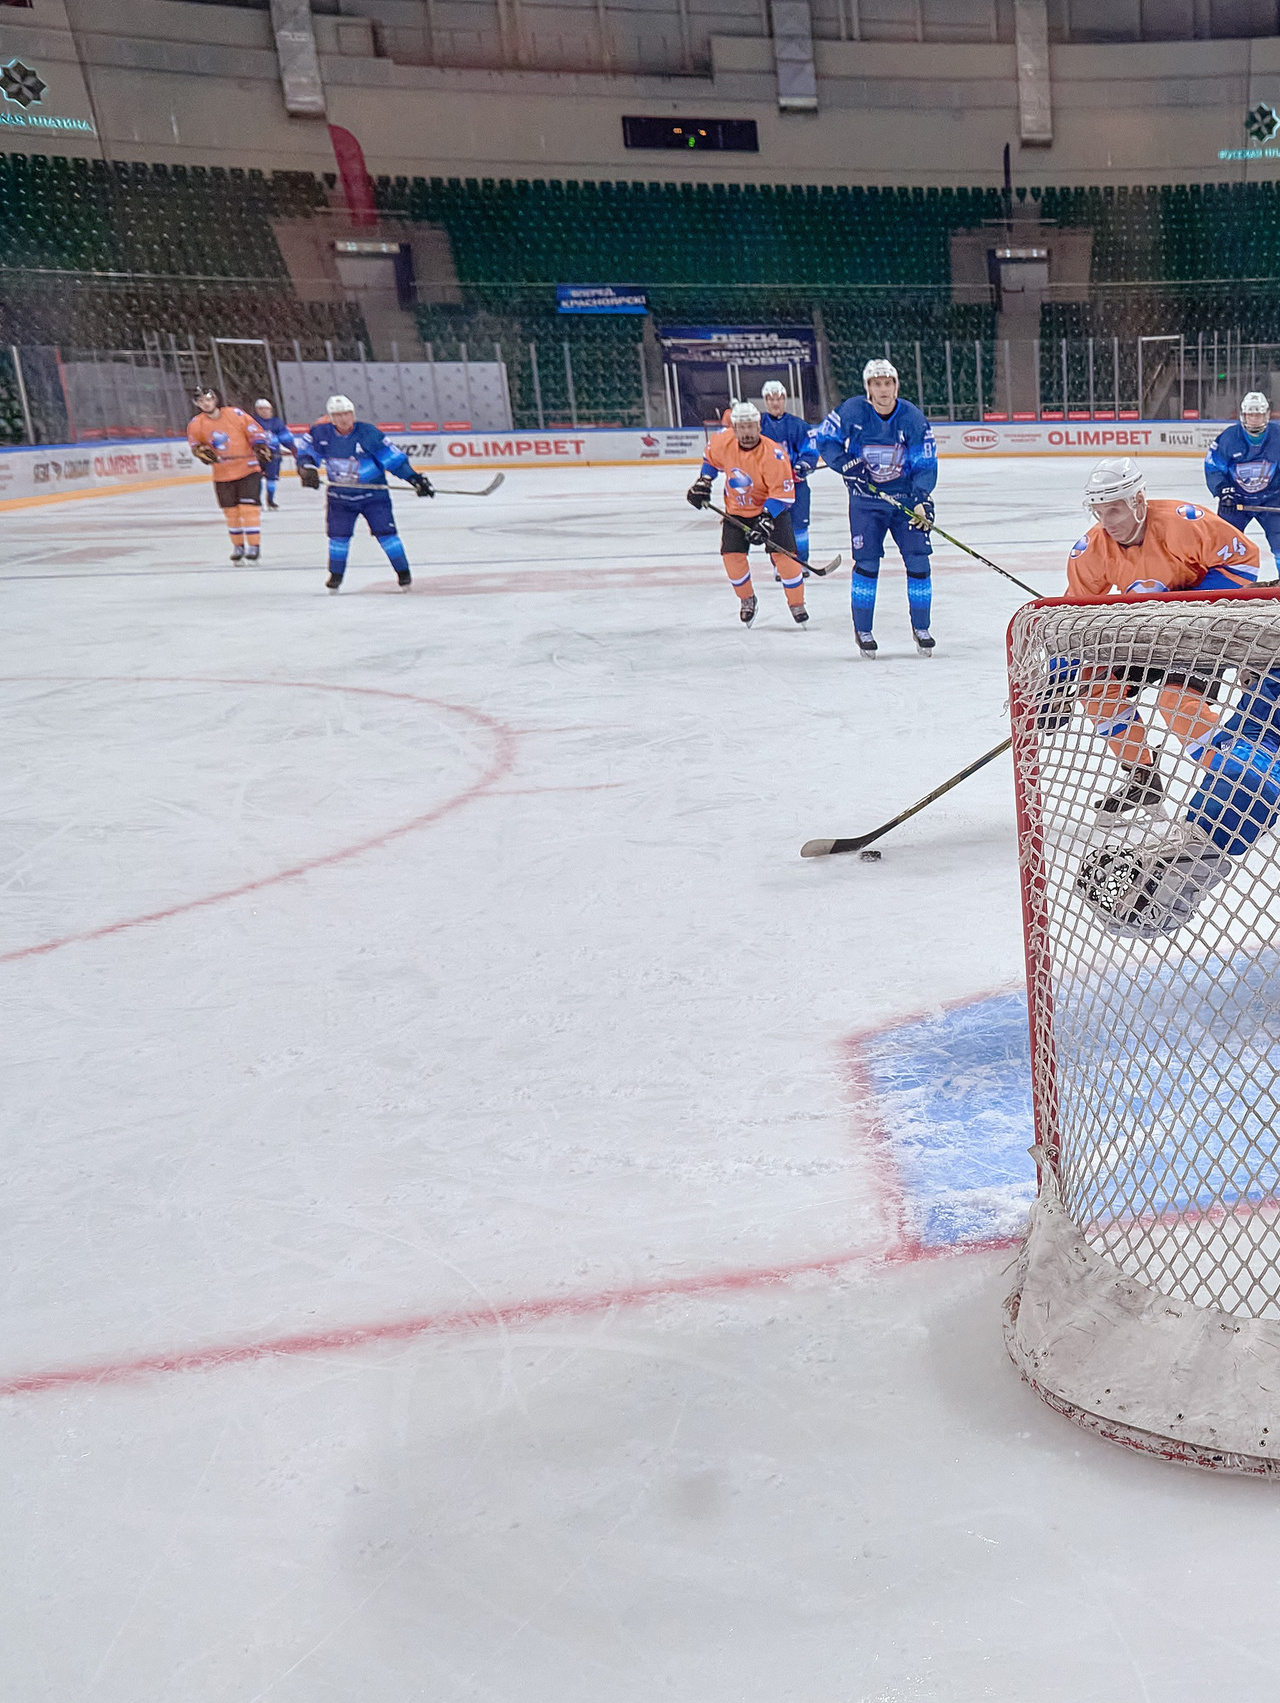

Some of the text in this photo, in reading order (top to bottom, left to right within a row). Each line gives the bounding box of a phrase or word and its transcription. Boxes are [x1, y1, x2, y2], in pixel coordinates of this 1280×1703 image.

[963, 434, 998, 443] SINTEC
[1048, 431, 1152, 446] OLIMPBET
[447, 440, 585, 457] OLIMPBET
